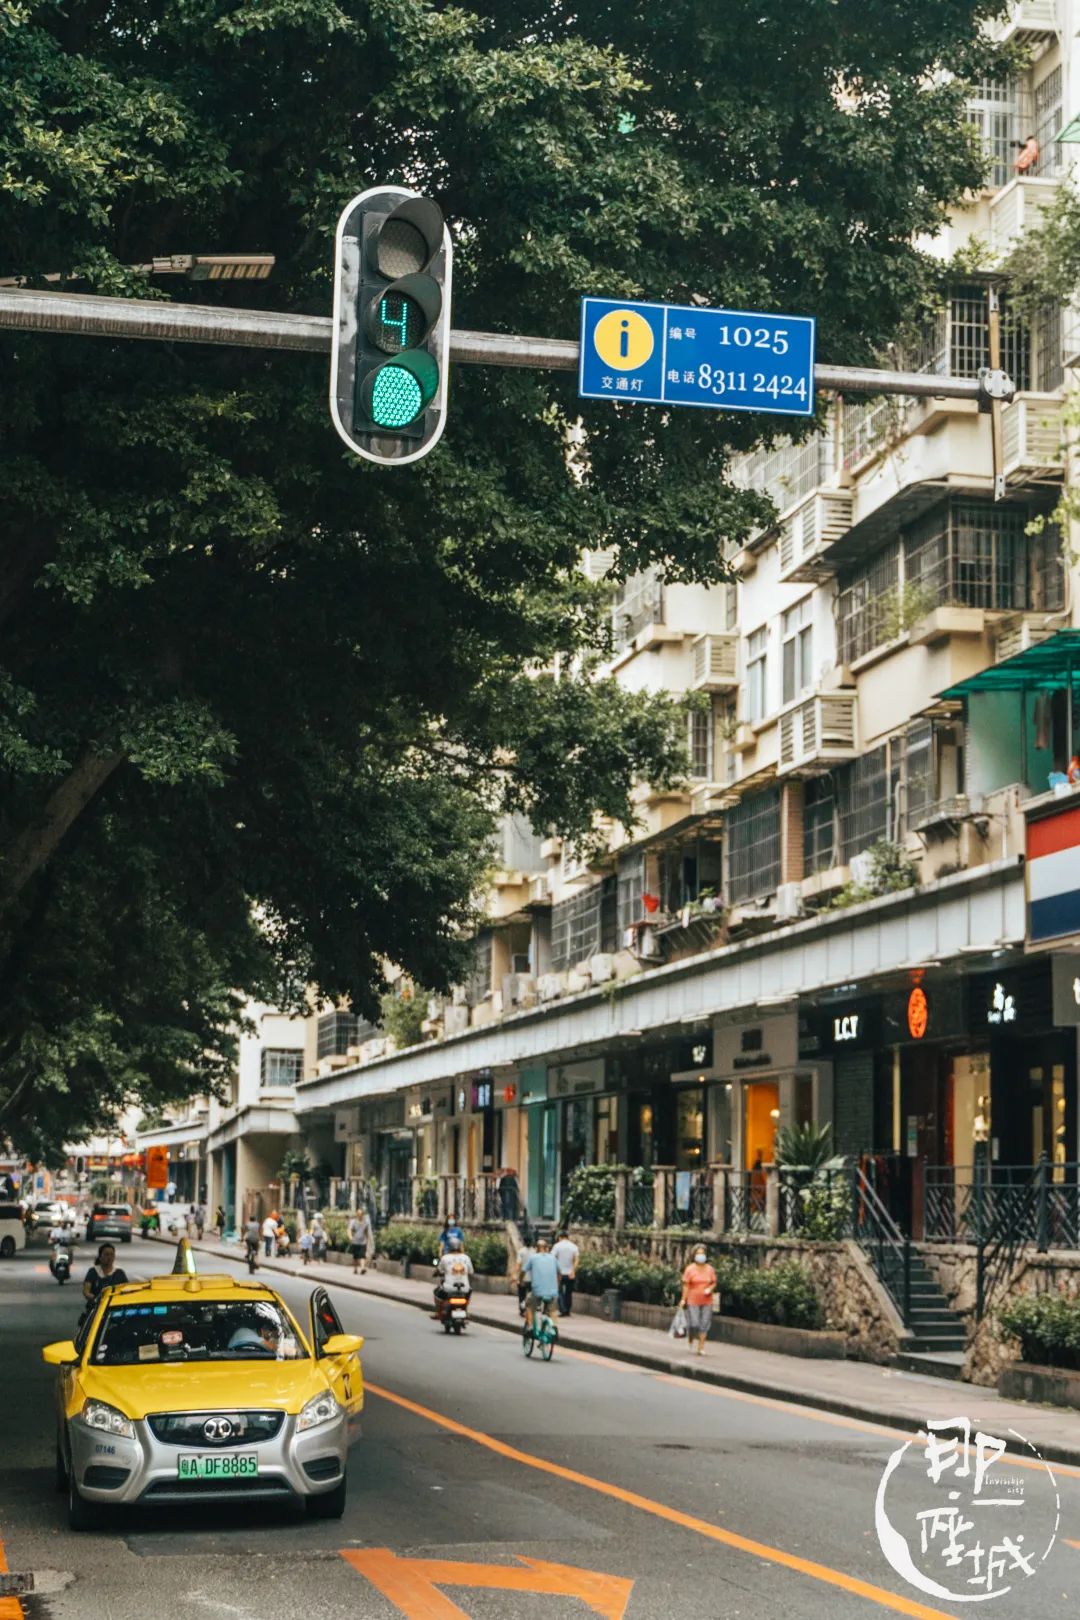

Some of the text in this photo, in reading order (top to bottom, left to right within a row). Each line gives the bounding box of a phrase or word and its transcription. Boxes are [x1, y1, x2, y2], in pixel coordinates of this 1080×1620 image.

[381, 299, 408, 346] 4
[668, 325, 789, 355] 编号 1025
[601, 375, 644, 392] 交通灯
[667, 363, 807, 402] 电话 8311 2424
[205, 1457, 256, 1474] DF8885
